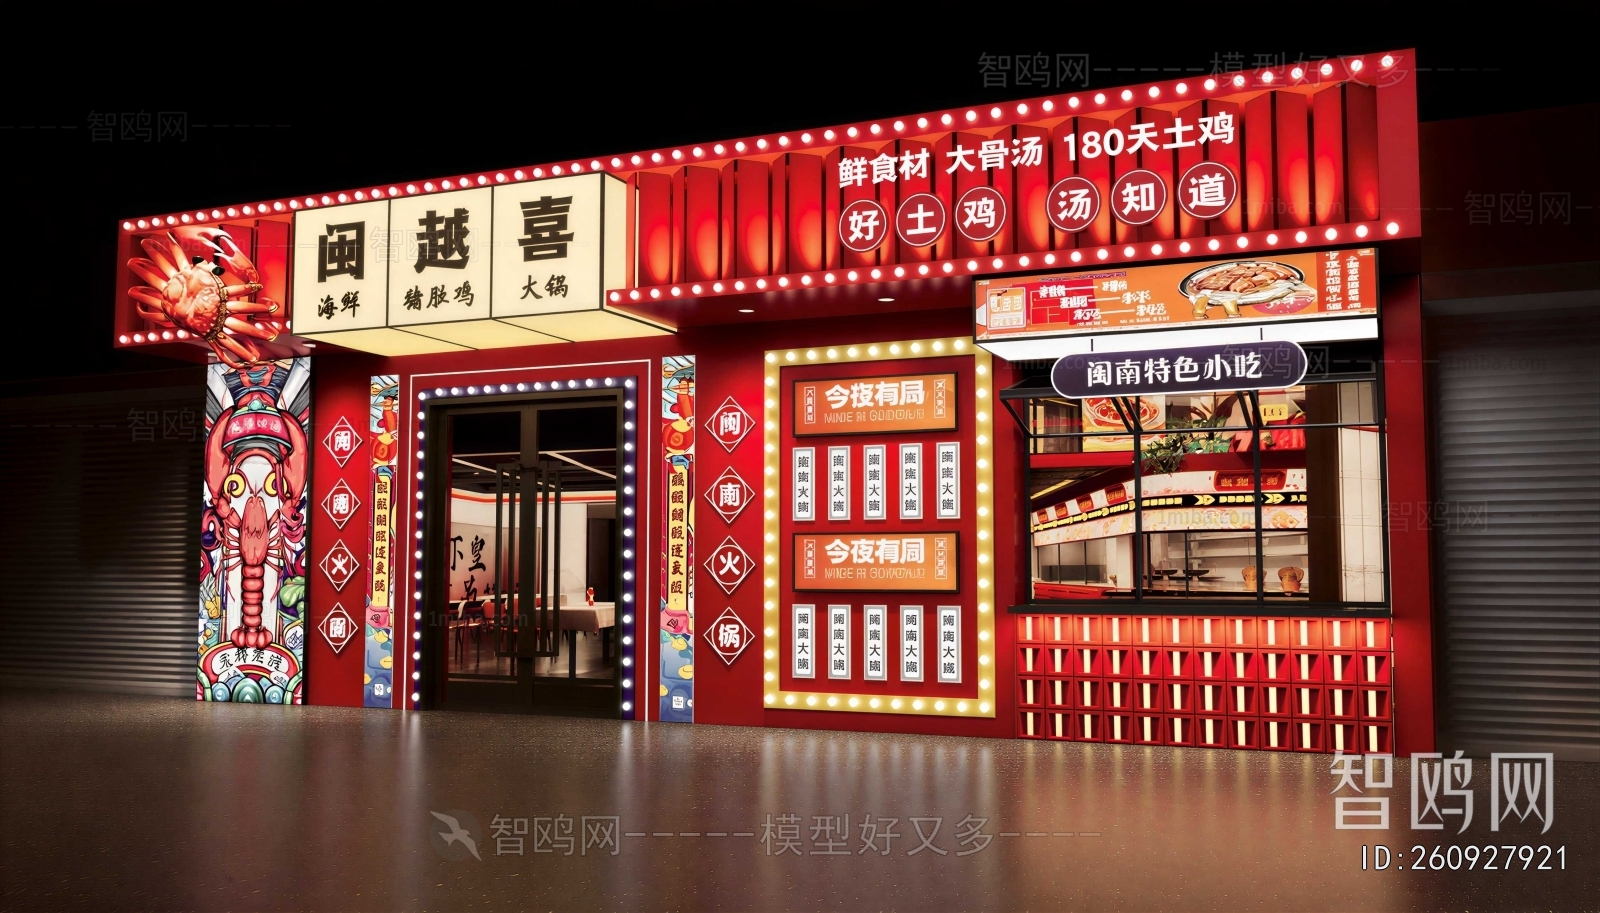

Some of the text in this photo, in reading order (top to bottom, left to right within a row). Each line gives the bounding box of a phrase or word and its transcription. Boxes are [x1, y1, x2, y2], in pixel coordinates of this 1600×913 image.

[838, 111, 1235, 189] 鲜食材 大骨汤 180天土鸡
[1057, 174, 1226, 222] 汤知道
[848, 197, 996, 243] 好土鸡
[317, 290, 361, 320] 海鲜
[520, 274, 568, 301] 大锅
[1087, 351, 1263, 387] 闽南特色小吃
